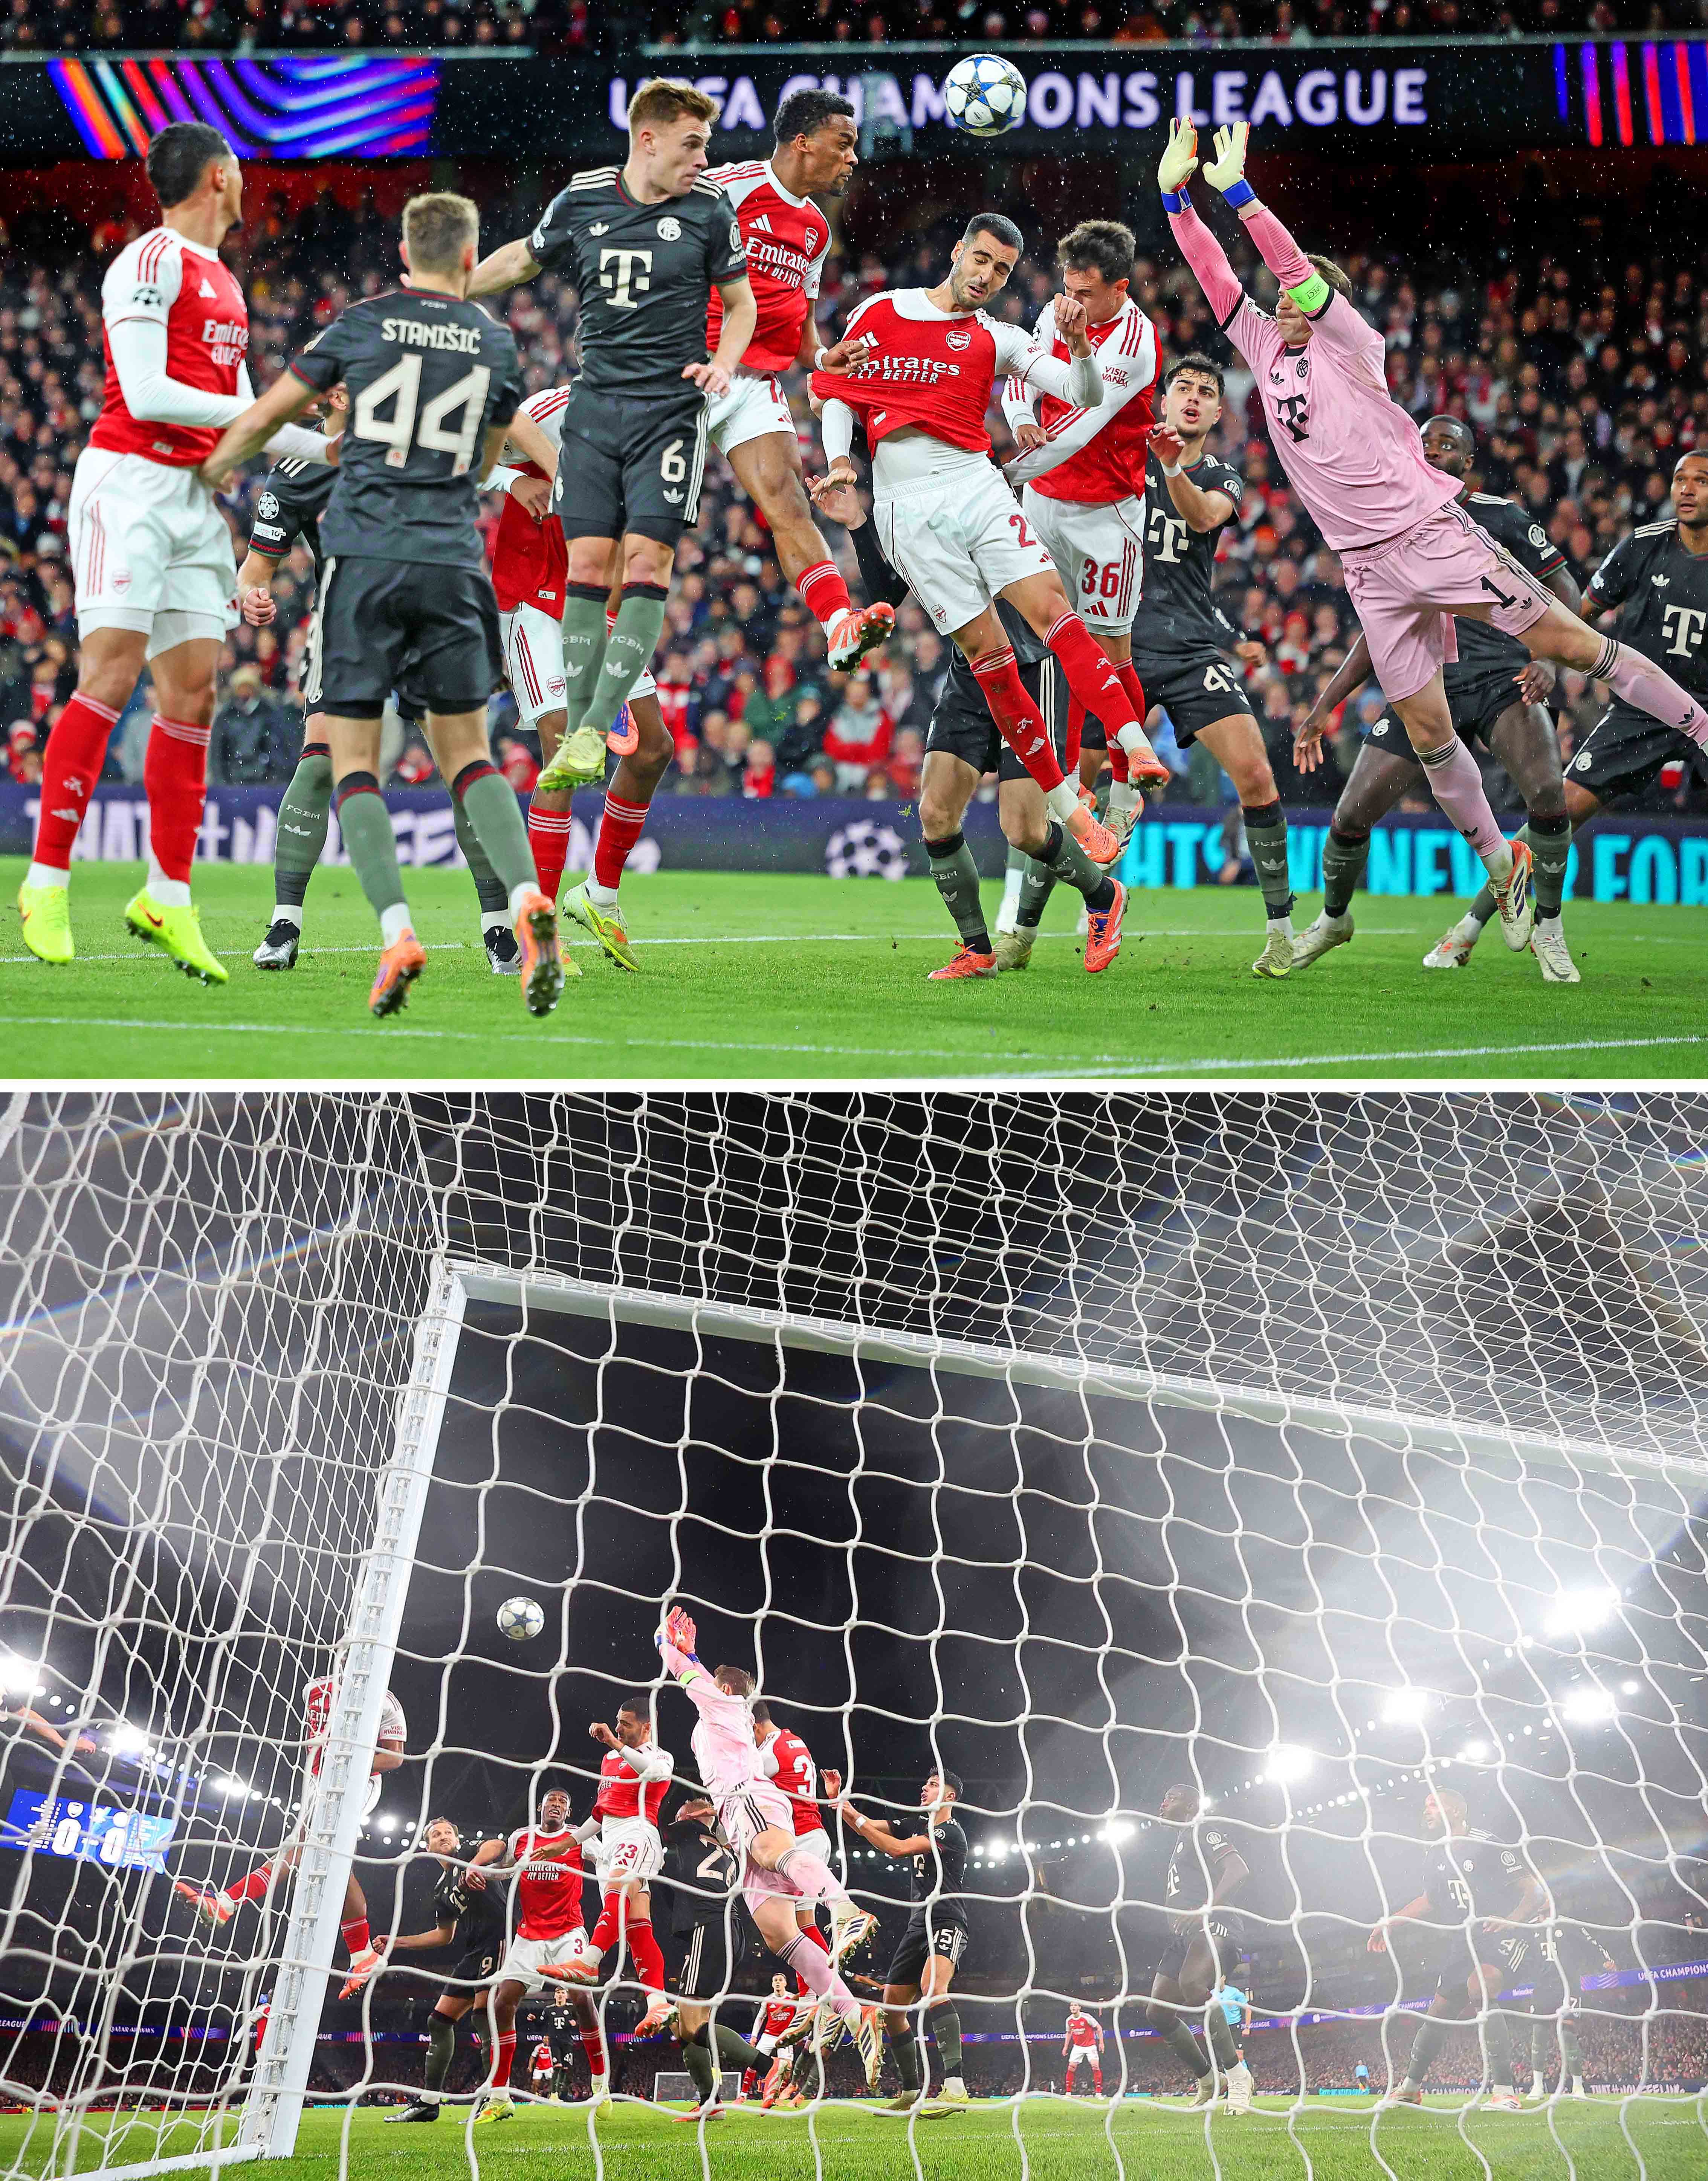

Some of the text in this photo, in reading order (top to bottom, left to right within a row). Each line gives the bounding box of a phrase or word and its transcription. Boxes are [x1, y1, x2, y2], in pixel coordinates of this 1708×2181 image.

[1175, 68, 1428, 127] LEAGUE
[745, 236, 809, 276] Emirate
[599, 248, 652, 309] T
[381, 317, 482, 355] STANIŠIĆ
[860, 355, 960, 376] mirates
[882, 369, 938, 384] BETTER
[1105, 366, 1127, 377] VISIT
[353, 353, 491, 477] 44
[660, 439, 686, 483] 6
[1009, 514, 1037, 548] 2
[1081, 558, 1120, 598] 36
[1480, 576, 1517, 609] 1
[286, 804, 321, 820] FCBM
[614, 1843, 638, 1859] 23
[537, 1872, 559, 1880] BETTER
[574, 1938, 583, 1955] 3
[481, 1956, 493, 1976] 9
